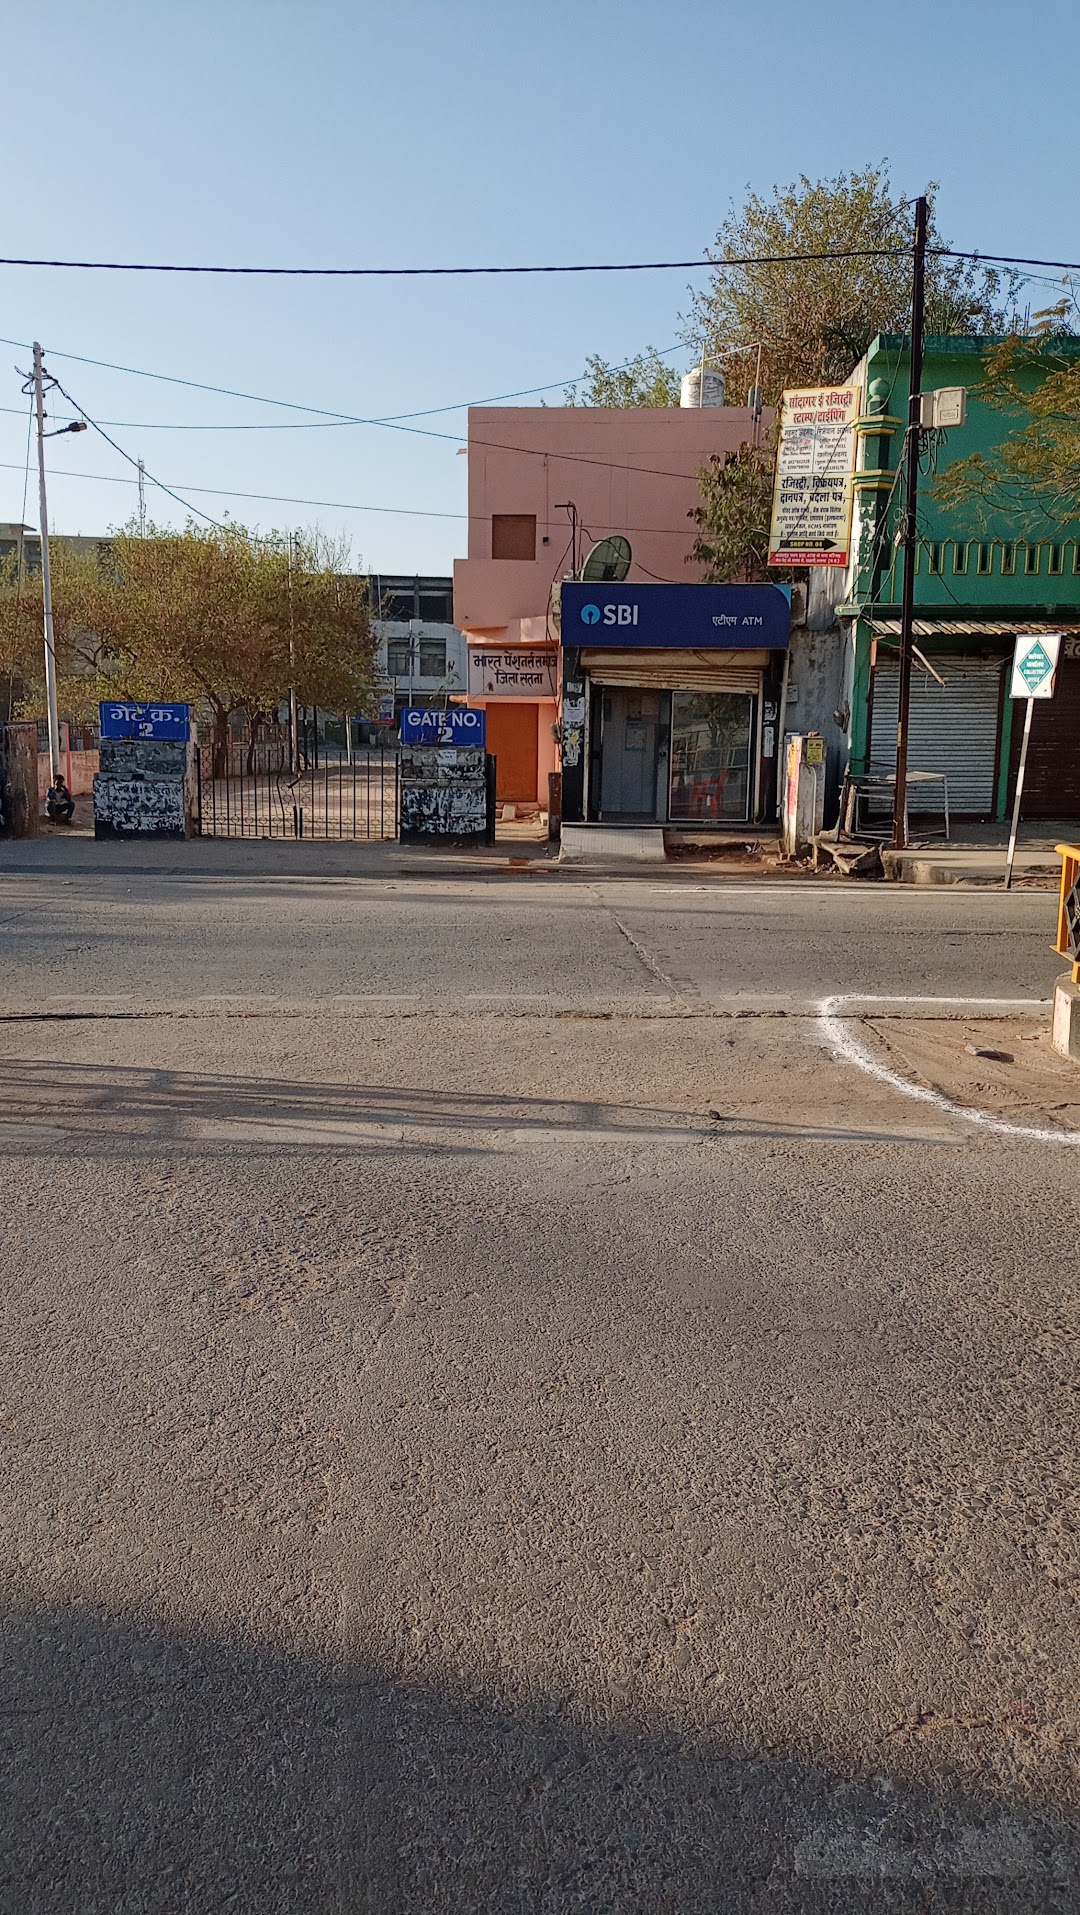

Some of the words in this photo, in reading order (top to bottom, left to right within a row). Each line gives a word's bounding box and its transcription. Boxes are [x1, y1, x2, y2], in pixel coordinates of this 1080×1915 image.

[826, 391, 853, 408] रजिस्ट्री
[782, 476, 810, 490] रजिस्ट्री,
[780, 492, 806, 505] दानपत्र,
[603, 604, 639, 625] SBI
[712, 614, 738, 626] एटीएम
[742, 616, 763, 625] ATM
[473, 656, 502, 670] भारत
[504, 651, 536, 670] पेंशनर्स
[494, 670, 518, 686] जिला
[520, 673, 543, 686] सतना
[408, 712, 447, 727] GATE
[452, 712, 480, 727] NO.
[139, 722, 154, 737] 2
[438, 727, 453, 742] 2
